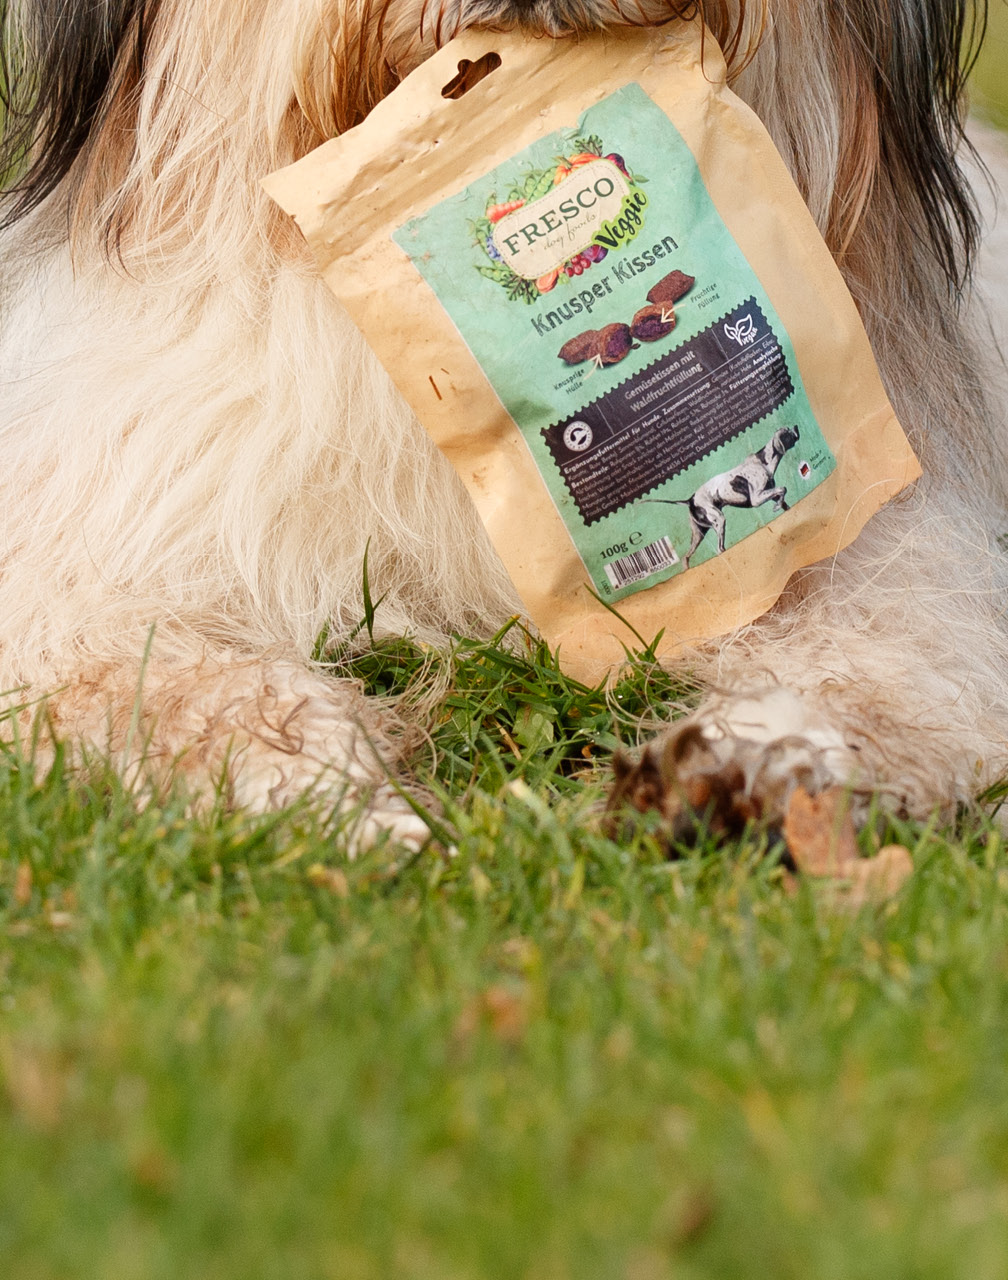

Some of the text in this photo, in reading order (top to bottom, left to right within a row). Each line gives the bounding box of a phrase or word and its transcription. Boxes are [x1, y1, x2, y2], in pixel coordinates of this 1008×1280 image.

[503, 177, 615, 257] FRESCO
[594, 192, 647, 249] Veggie
[530, 235, 679, 337] Knusper Kissen
[623, 349, 695, 400] Gemüsekissen mit
[629, 361, 703, 413] Waldfruchtfüllung
[600, 540, 629, 562] 100g
